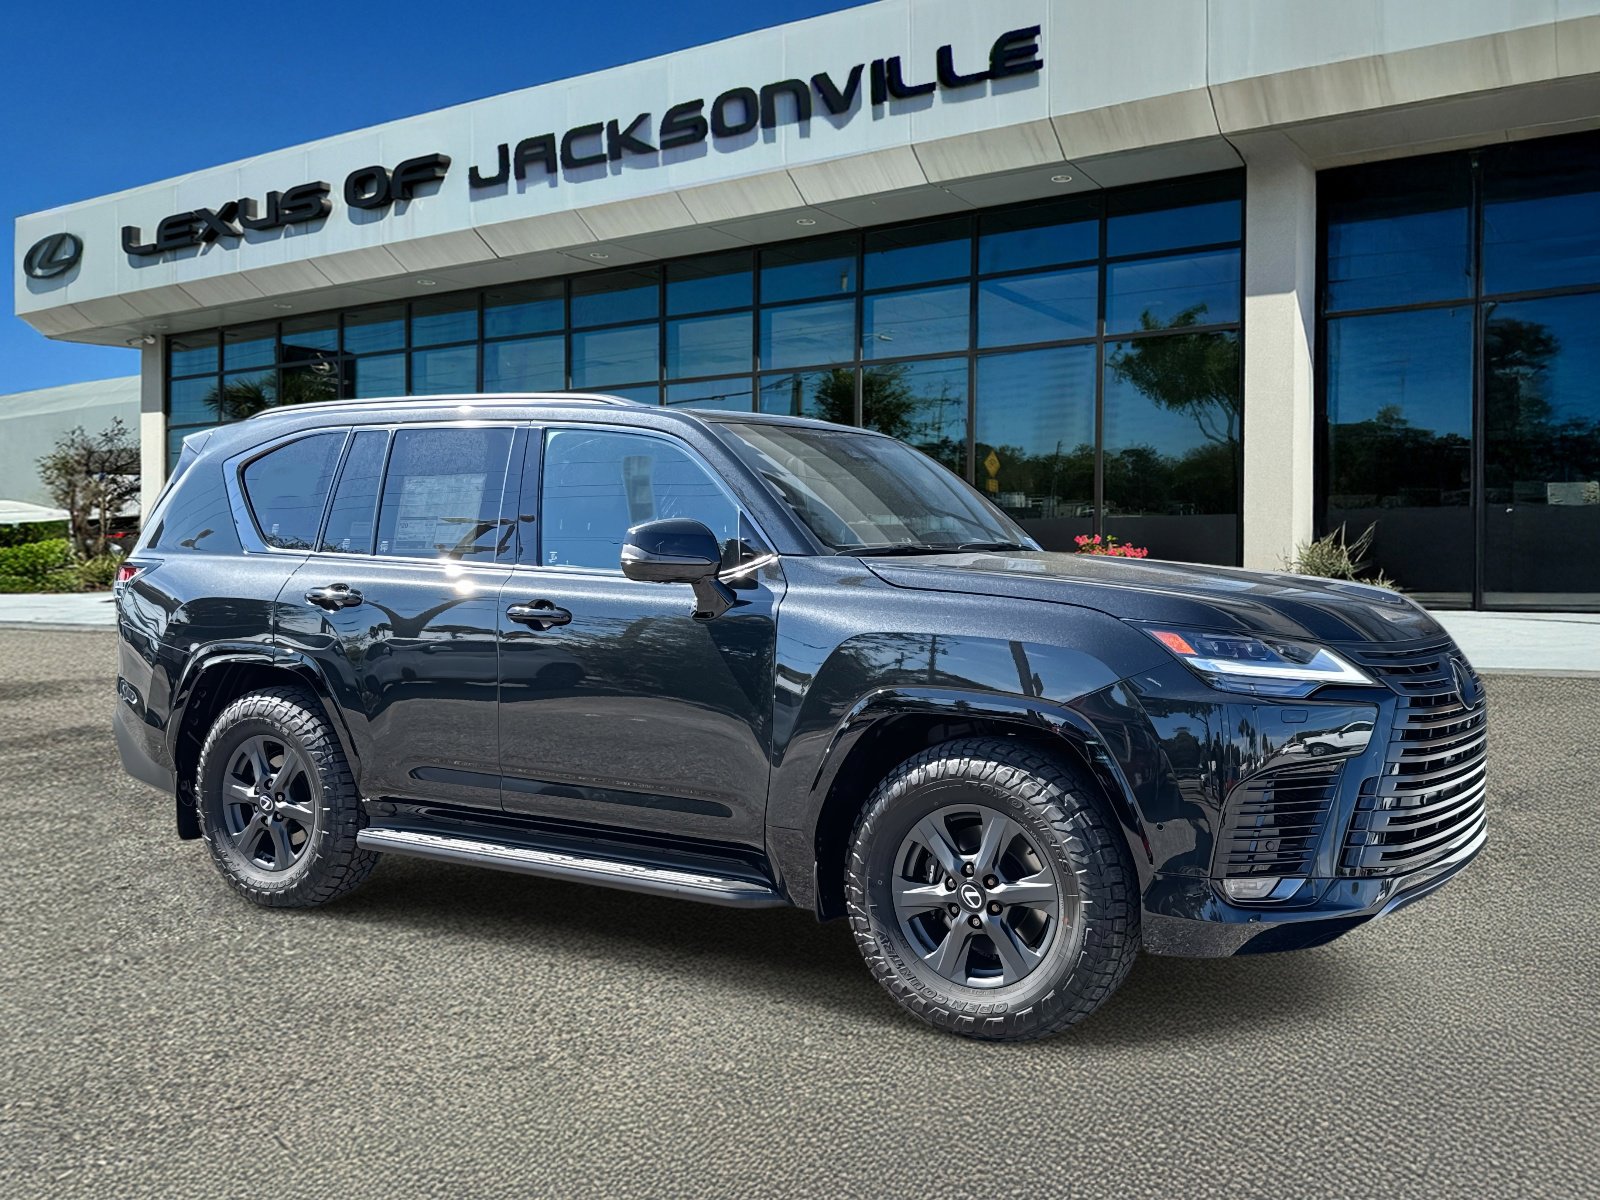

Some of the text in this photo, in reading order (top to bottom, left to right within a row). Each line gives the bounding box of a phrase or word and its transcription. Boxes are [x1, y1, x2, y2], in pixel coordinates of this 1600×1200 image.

[121, 24, 1044, 256] LEXUS OF JACKSONVILLE
[876, 930, 1009, 1015] OPEN COUNTRY
